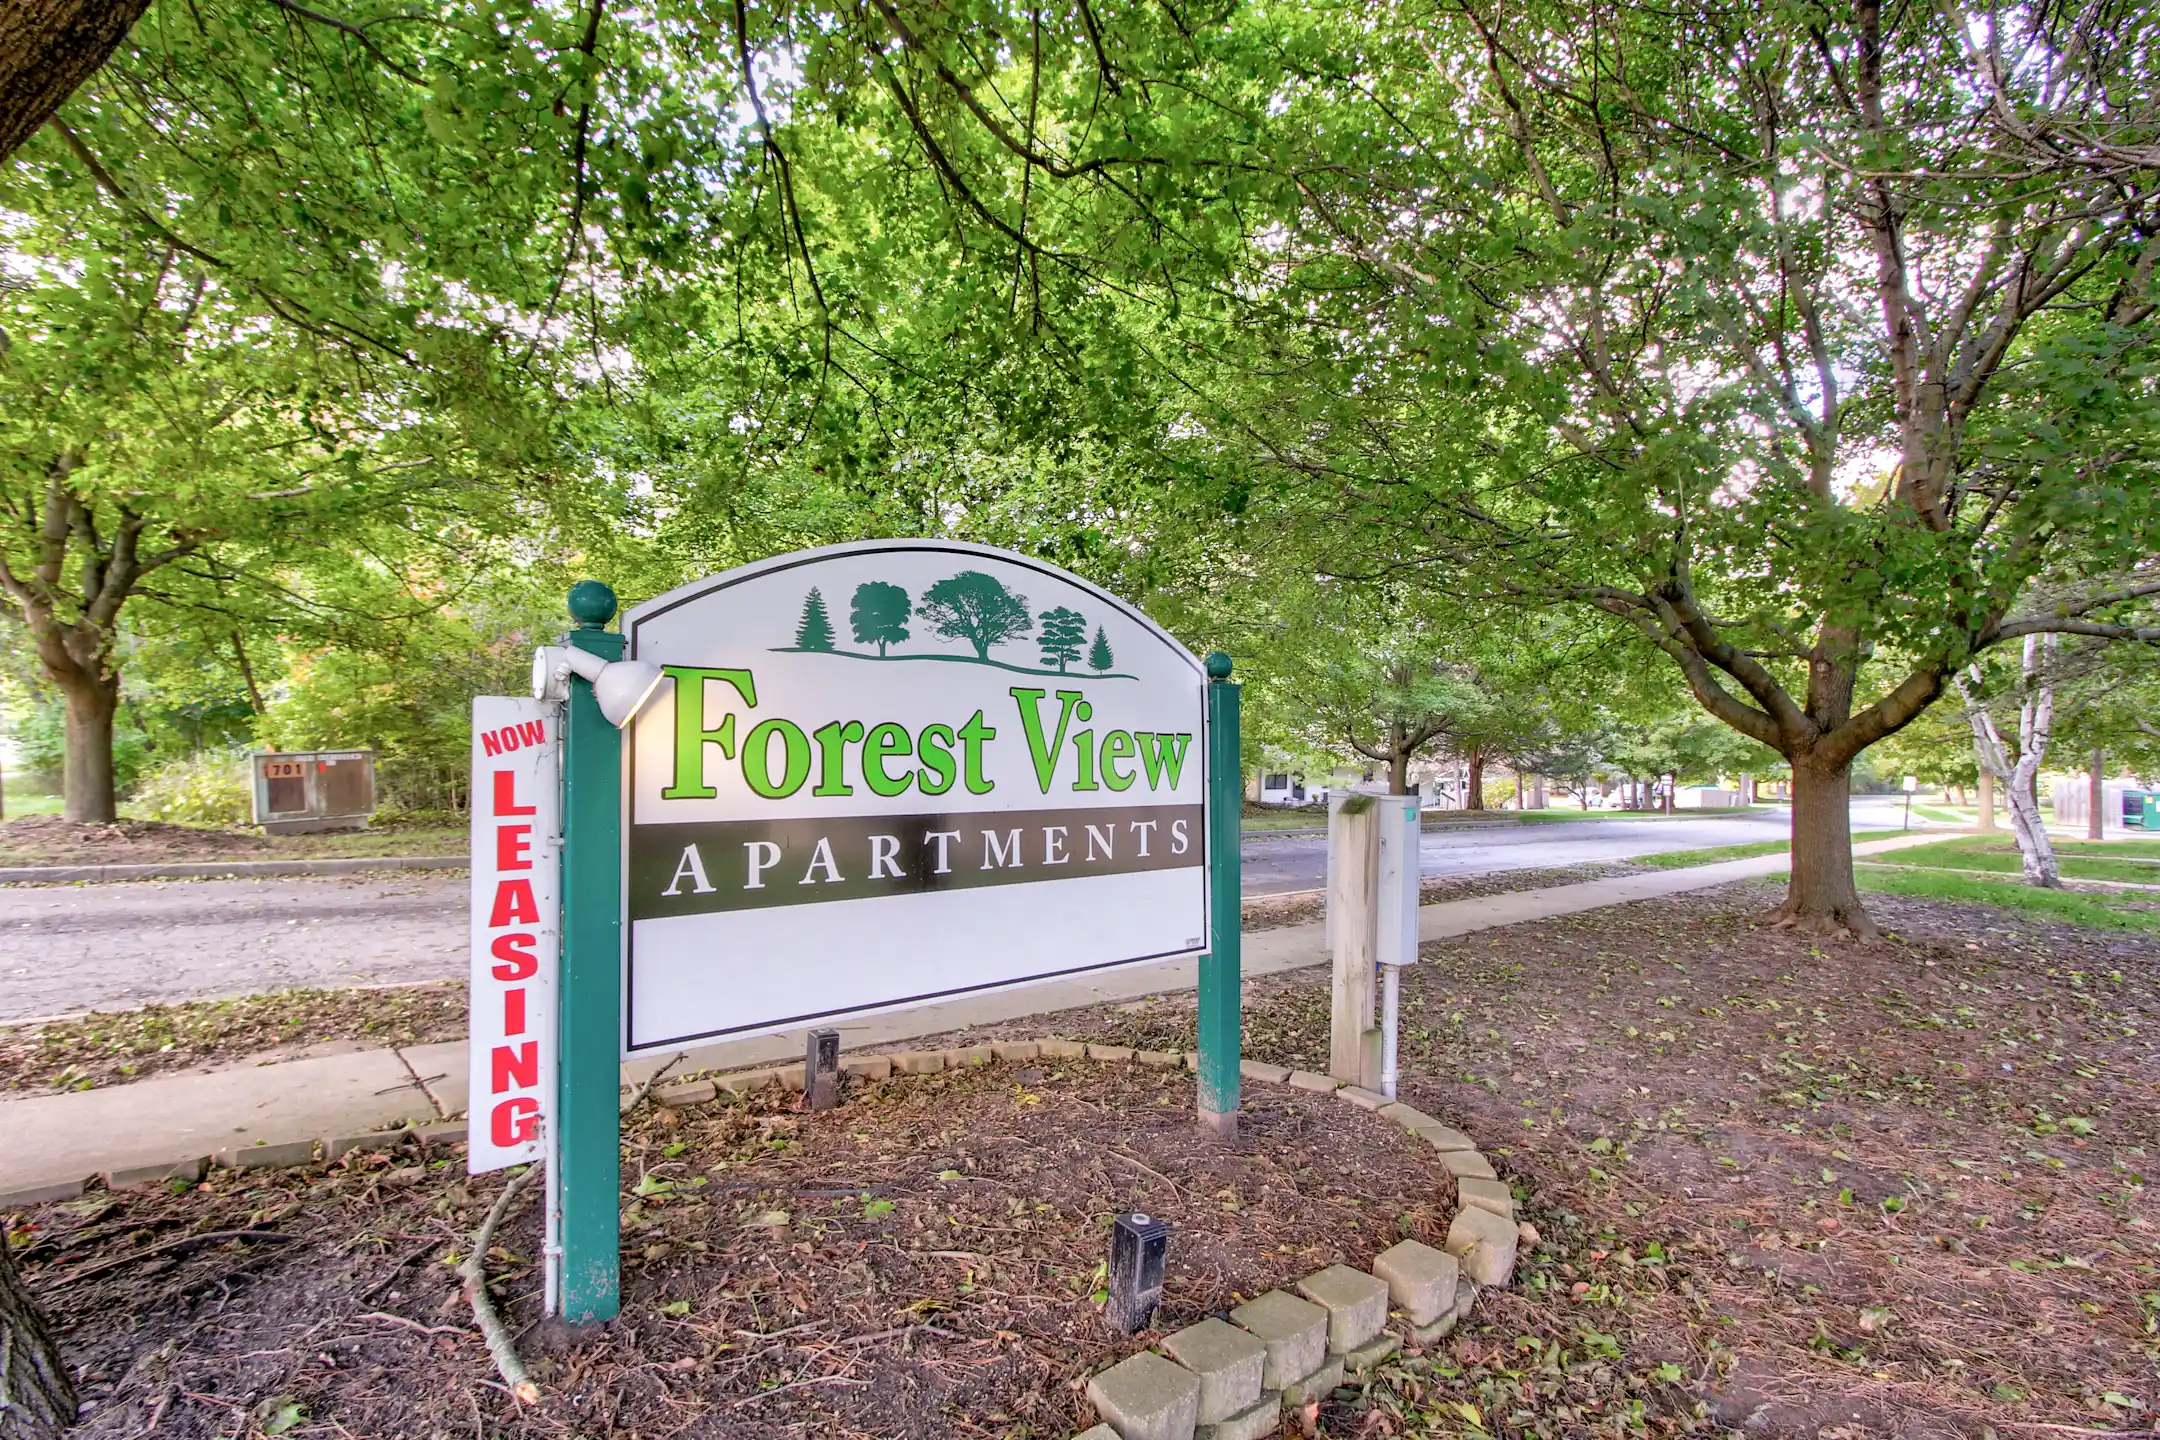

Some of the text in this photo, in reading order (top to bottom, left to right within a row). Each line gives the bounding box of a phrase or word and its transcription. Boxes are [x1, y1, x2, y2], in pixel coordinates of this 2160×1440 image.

[481, 719, 546, 757] NOW
[661, 664, 1193, 800] Forest View
[661, 819, 1189, 896] APARTMENTS
[488, 770, 541, 1148] LEASING
